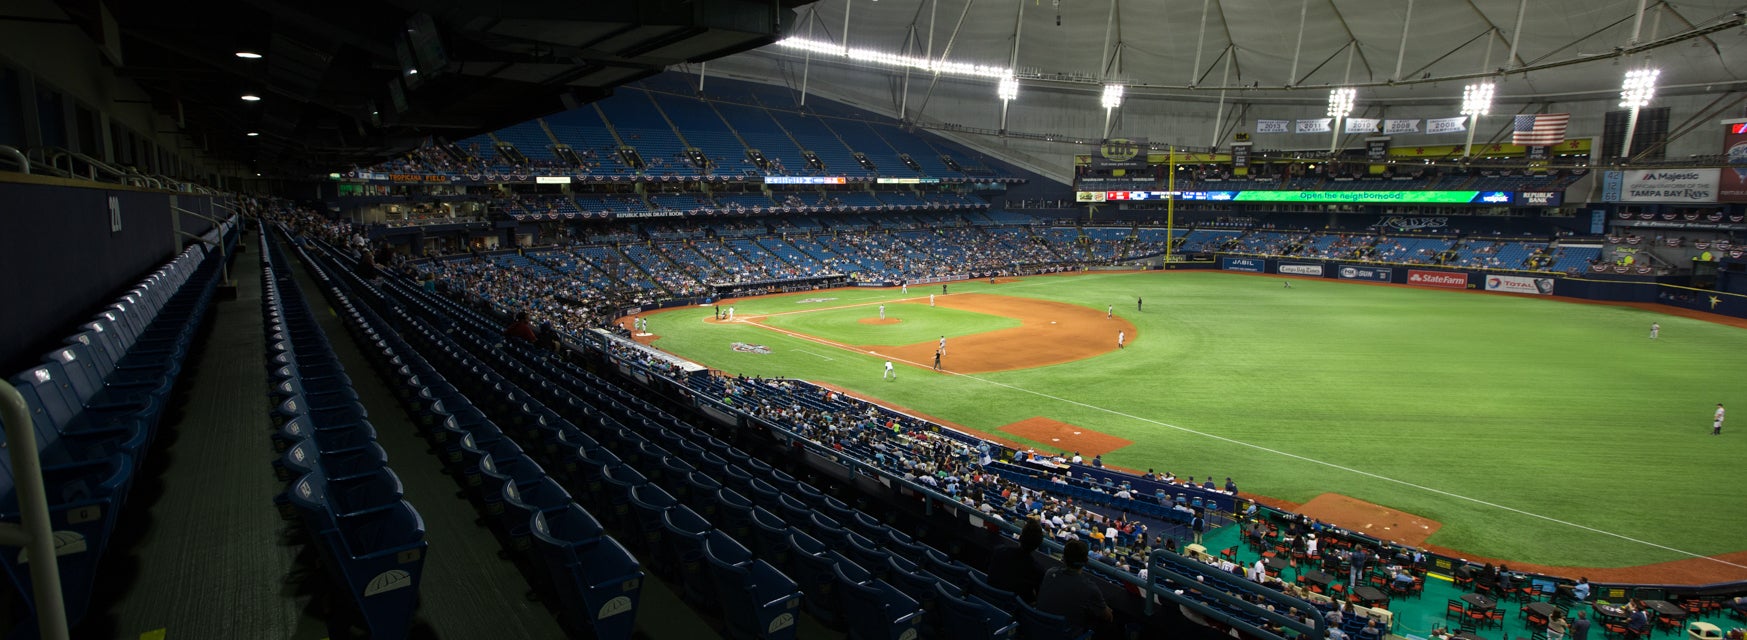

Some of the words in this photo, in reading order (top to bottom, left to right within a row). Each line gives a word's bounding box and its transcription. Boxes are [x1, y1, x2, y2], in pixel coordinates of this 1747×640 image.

[1658, 172, 1699, 182] Majestic
[1607, 182, 1617, 190] 12
[1300, 192, 1322, 200] Open
[1358, 270, 1374, 278] SUN
[1504, 280, 1533, 288] TOTAL
